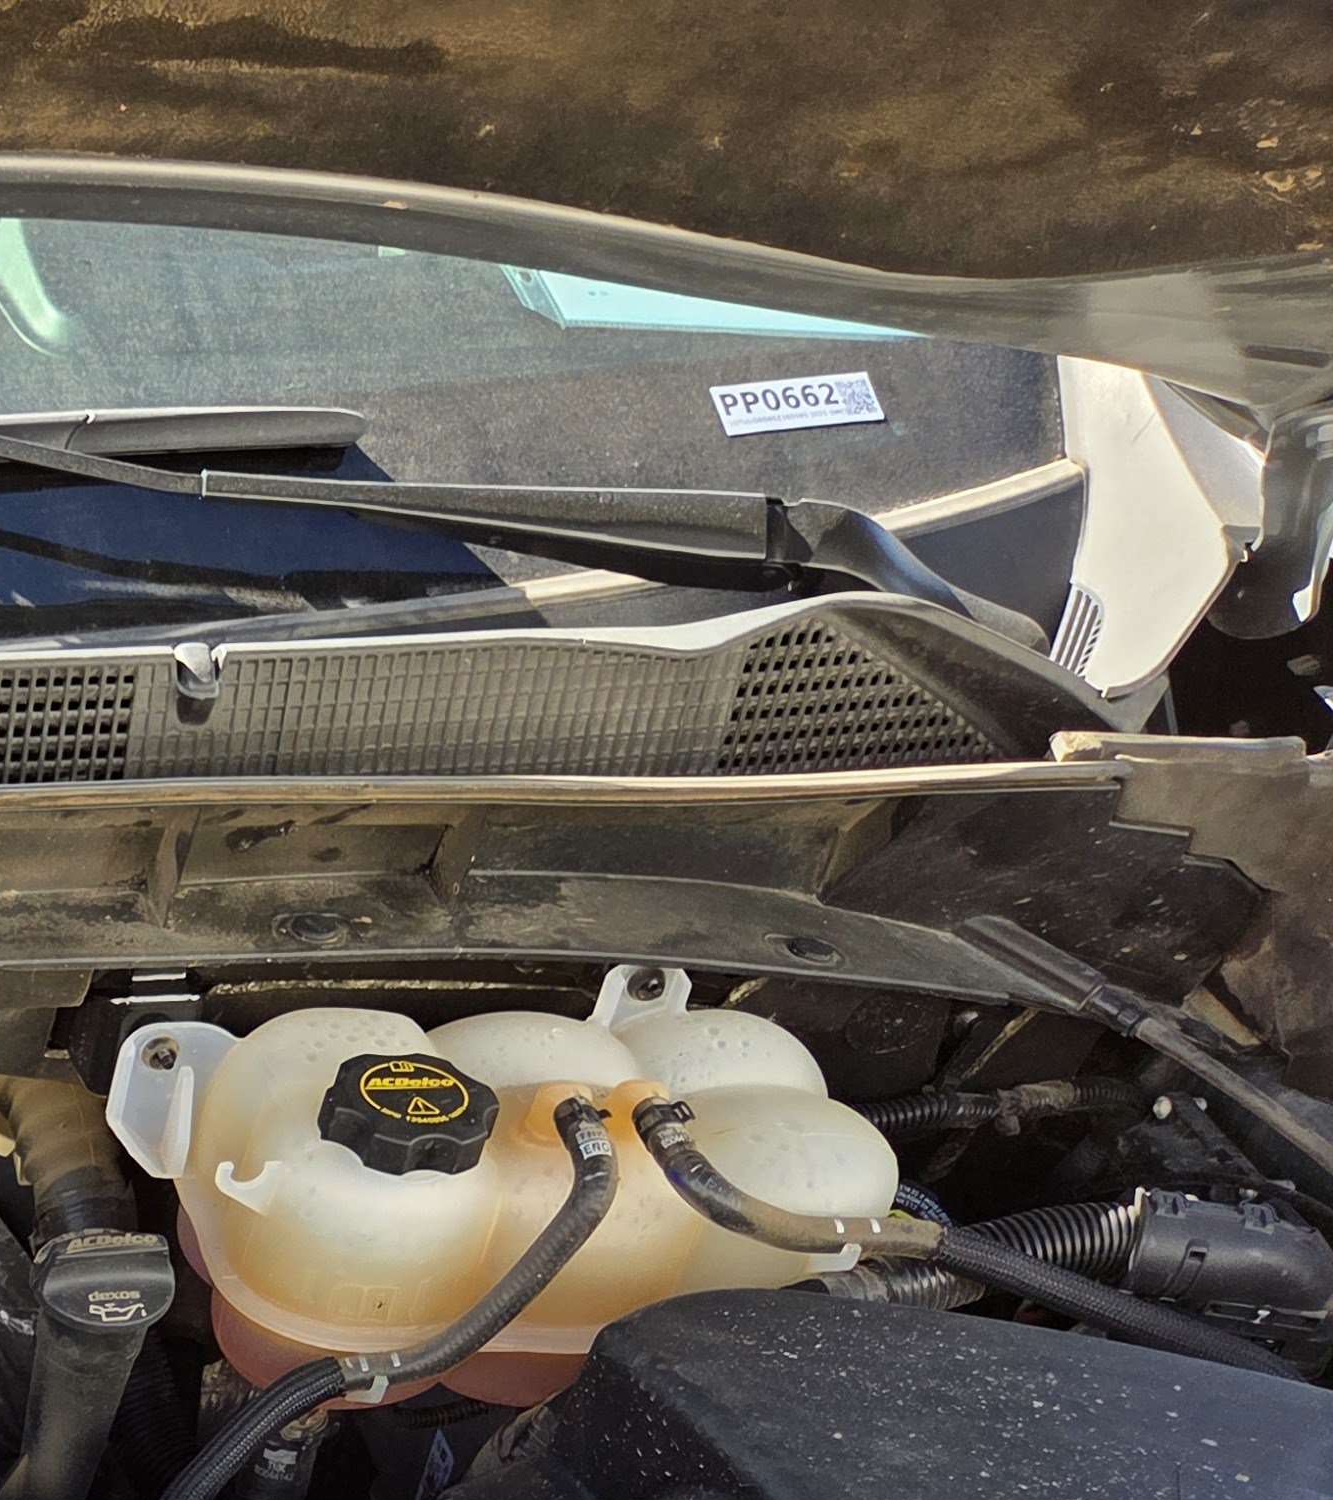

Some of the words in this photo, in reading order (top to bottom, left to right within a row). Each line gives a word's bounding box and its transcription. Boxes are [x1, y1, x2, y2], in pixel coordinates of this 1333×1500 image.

[719, 383, 839, 416] PP0662
[365, 1077, 454, 1089] ACDelco
[66, 1233, 159, 1253] ACDelco
[88, 1290, 141, 1302] dexos
